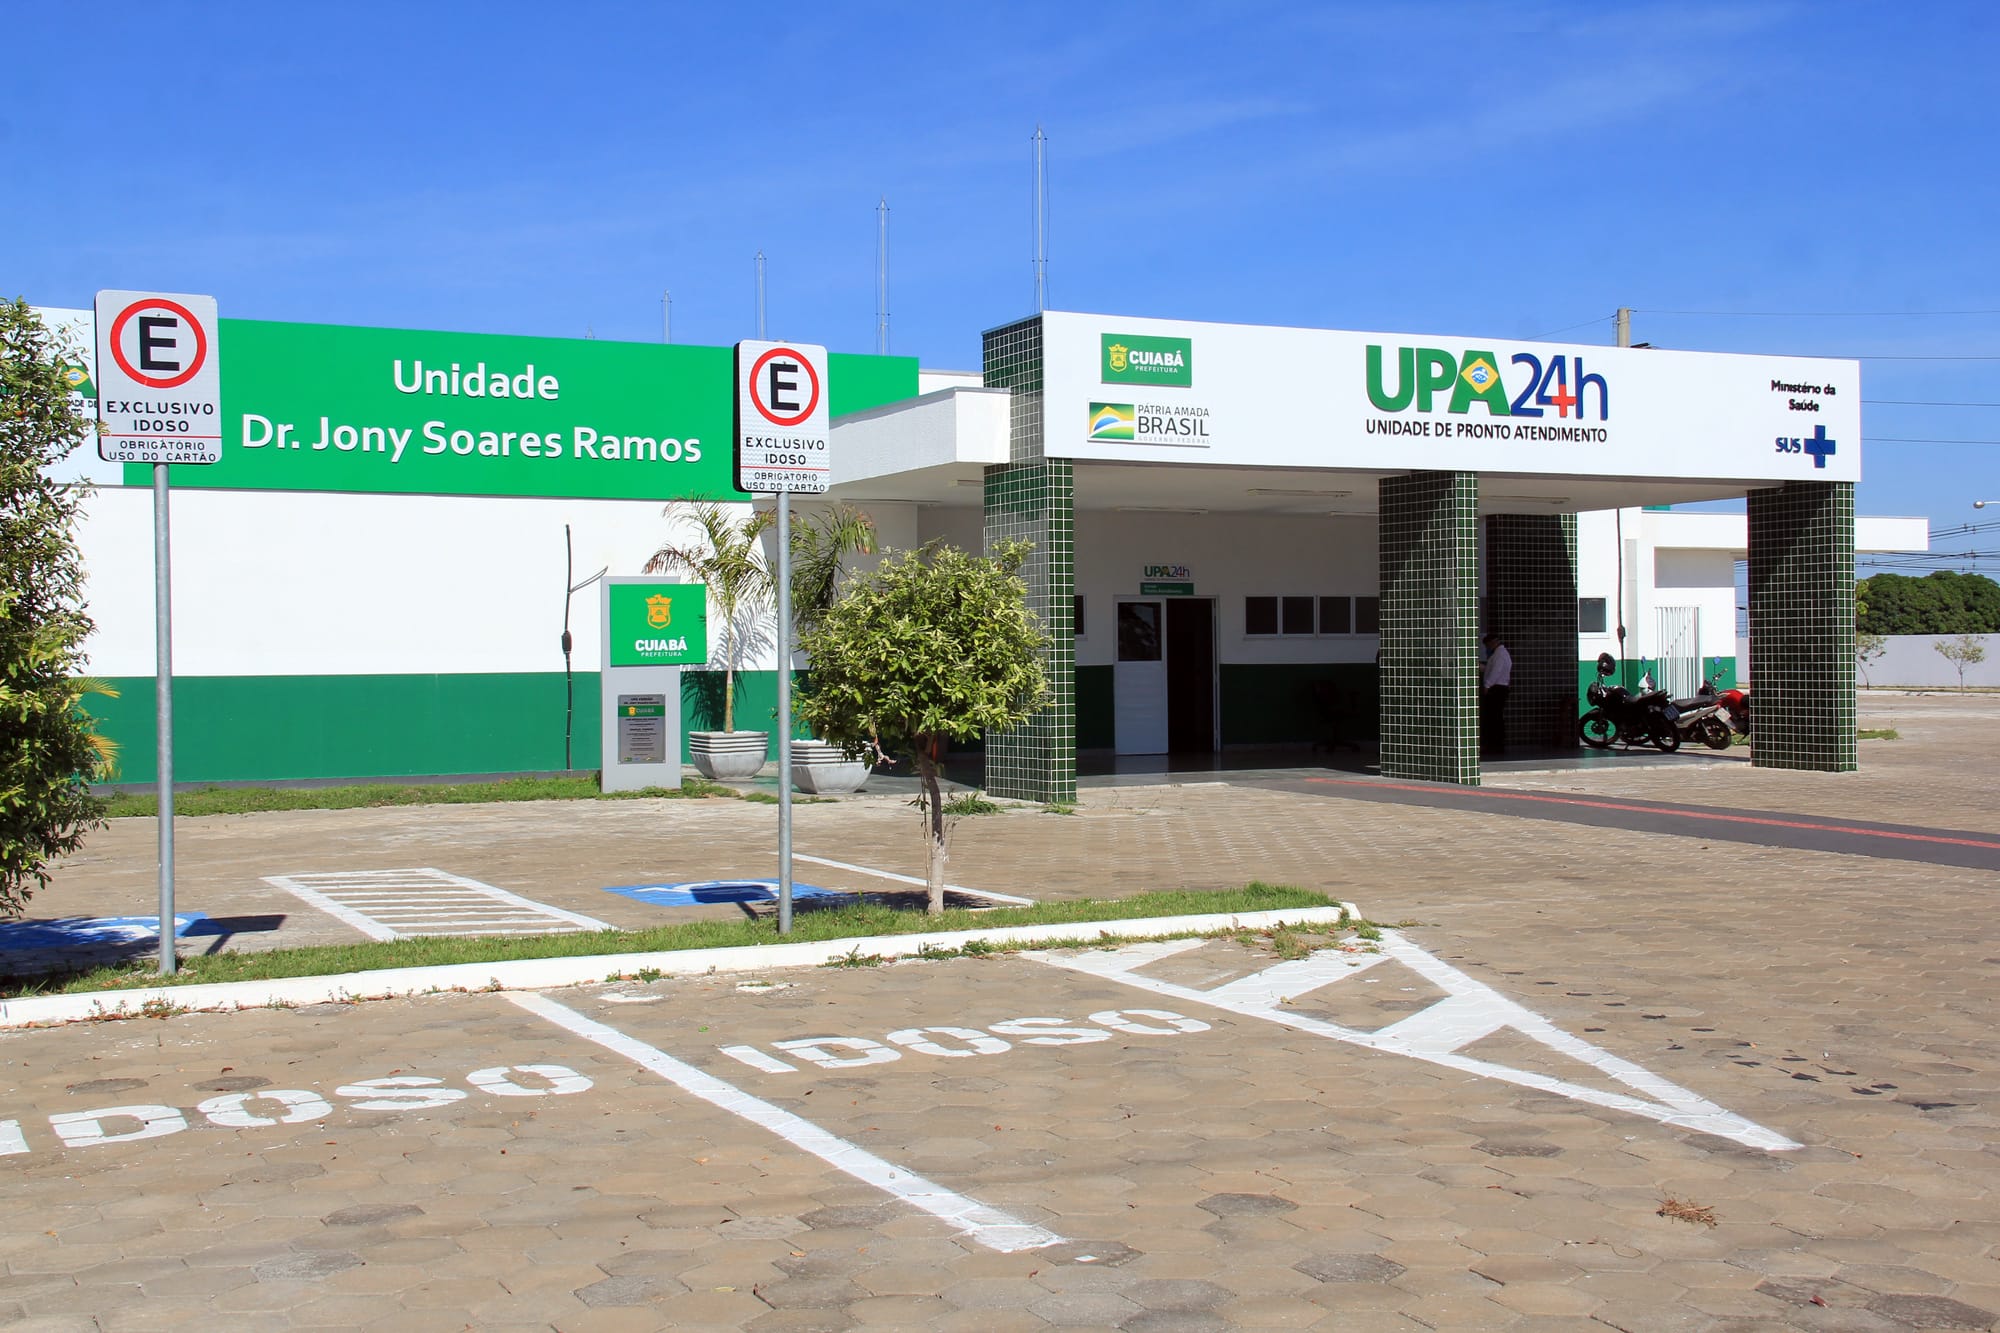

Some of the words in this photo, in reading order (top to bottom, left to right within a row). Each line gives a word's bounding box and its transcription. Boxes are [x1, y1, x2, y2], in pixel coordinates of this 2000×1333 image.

[138, 315, 180, 372] E
[1129, 350, 1184, 367] CUIABÁ
[393, 360, 559, 400] Unidade
[769, 363, 801, 412] E
[1771, 380, 1822, 395] Ministério
[1824, 384, 1836, 396] da
[106, 400, 214, 416] EXCLUSIVO
[1138, 403, 1172, 416] PÁTRIA
[1174, 406, 1210, 417] AMADA
[1788, 398, 1820, 412] Saúde
[133, 419, 190, 433] IDOSO
[1138, 415, 1210, 437] BRASIL
[1366, 418, 1431, 437] UNIDADE
[1434, 422, 1453, 437] DE
[1456, 423, 1512, 440] PRONTO
[1513, 425, 1608, 443] ATENDIMENTO
[242, 414, 300, 449] Dr.
[312, 416, 413, 463] Jony
[422, 420, 563, 458] Soares
[573, 426, 702, 463] Ramos
[745, 436, 825, 451] EXCLUSIVO
[1775, 437, 1802, 453] SUS
[109, 452, 136, 463] USO
[142, 452, 160, 463] DO
[765, 453, 807, 465] IDOSO
[746, 481, 766, 490] USO
[770, 482, 783, 491] DO
[635, 636, 688, 652] CUIABÁ
[718, 1009, 1212, 1074] IDOSO
